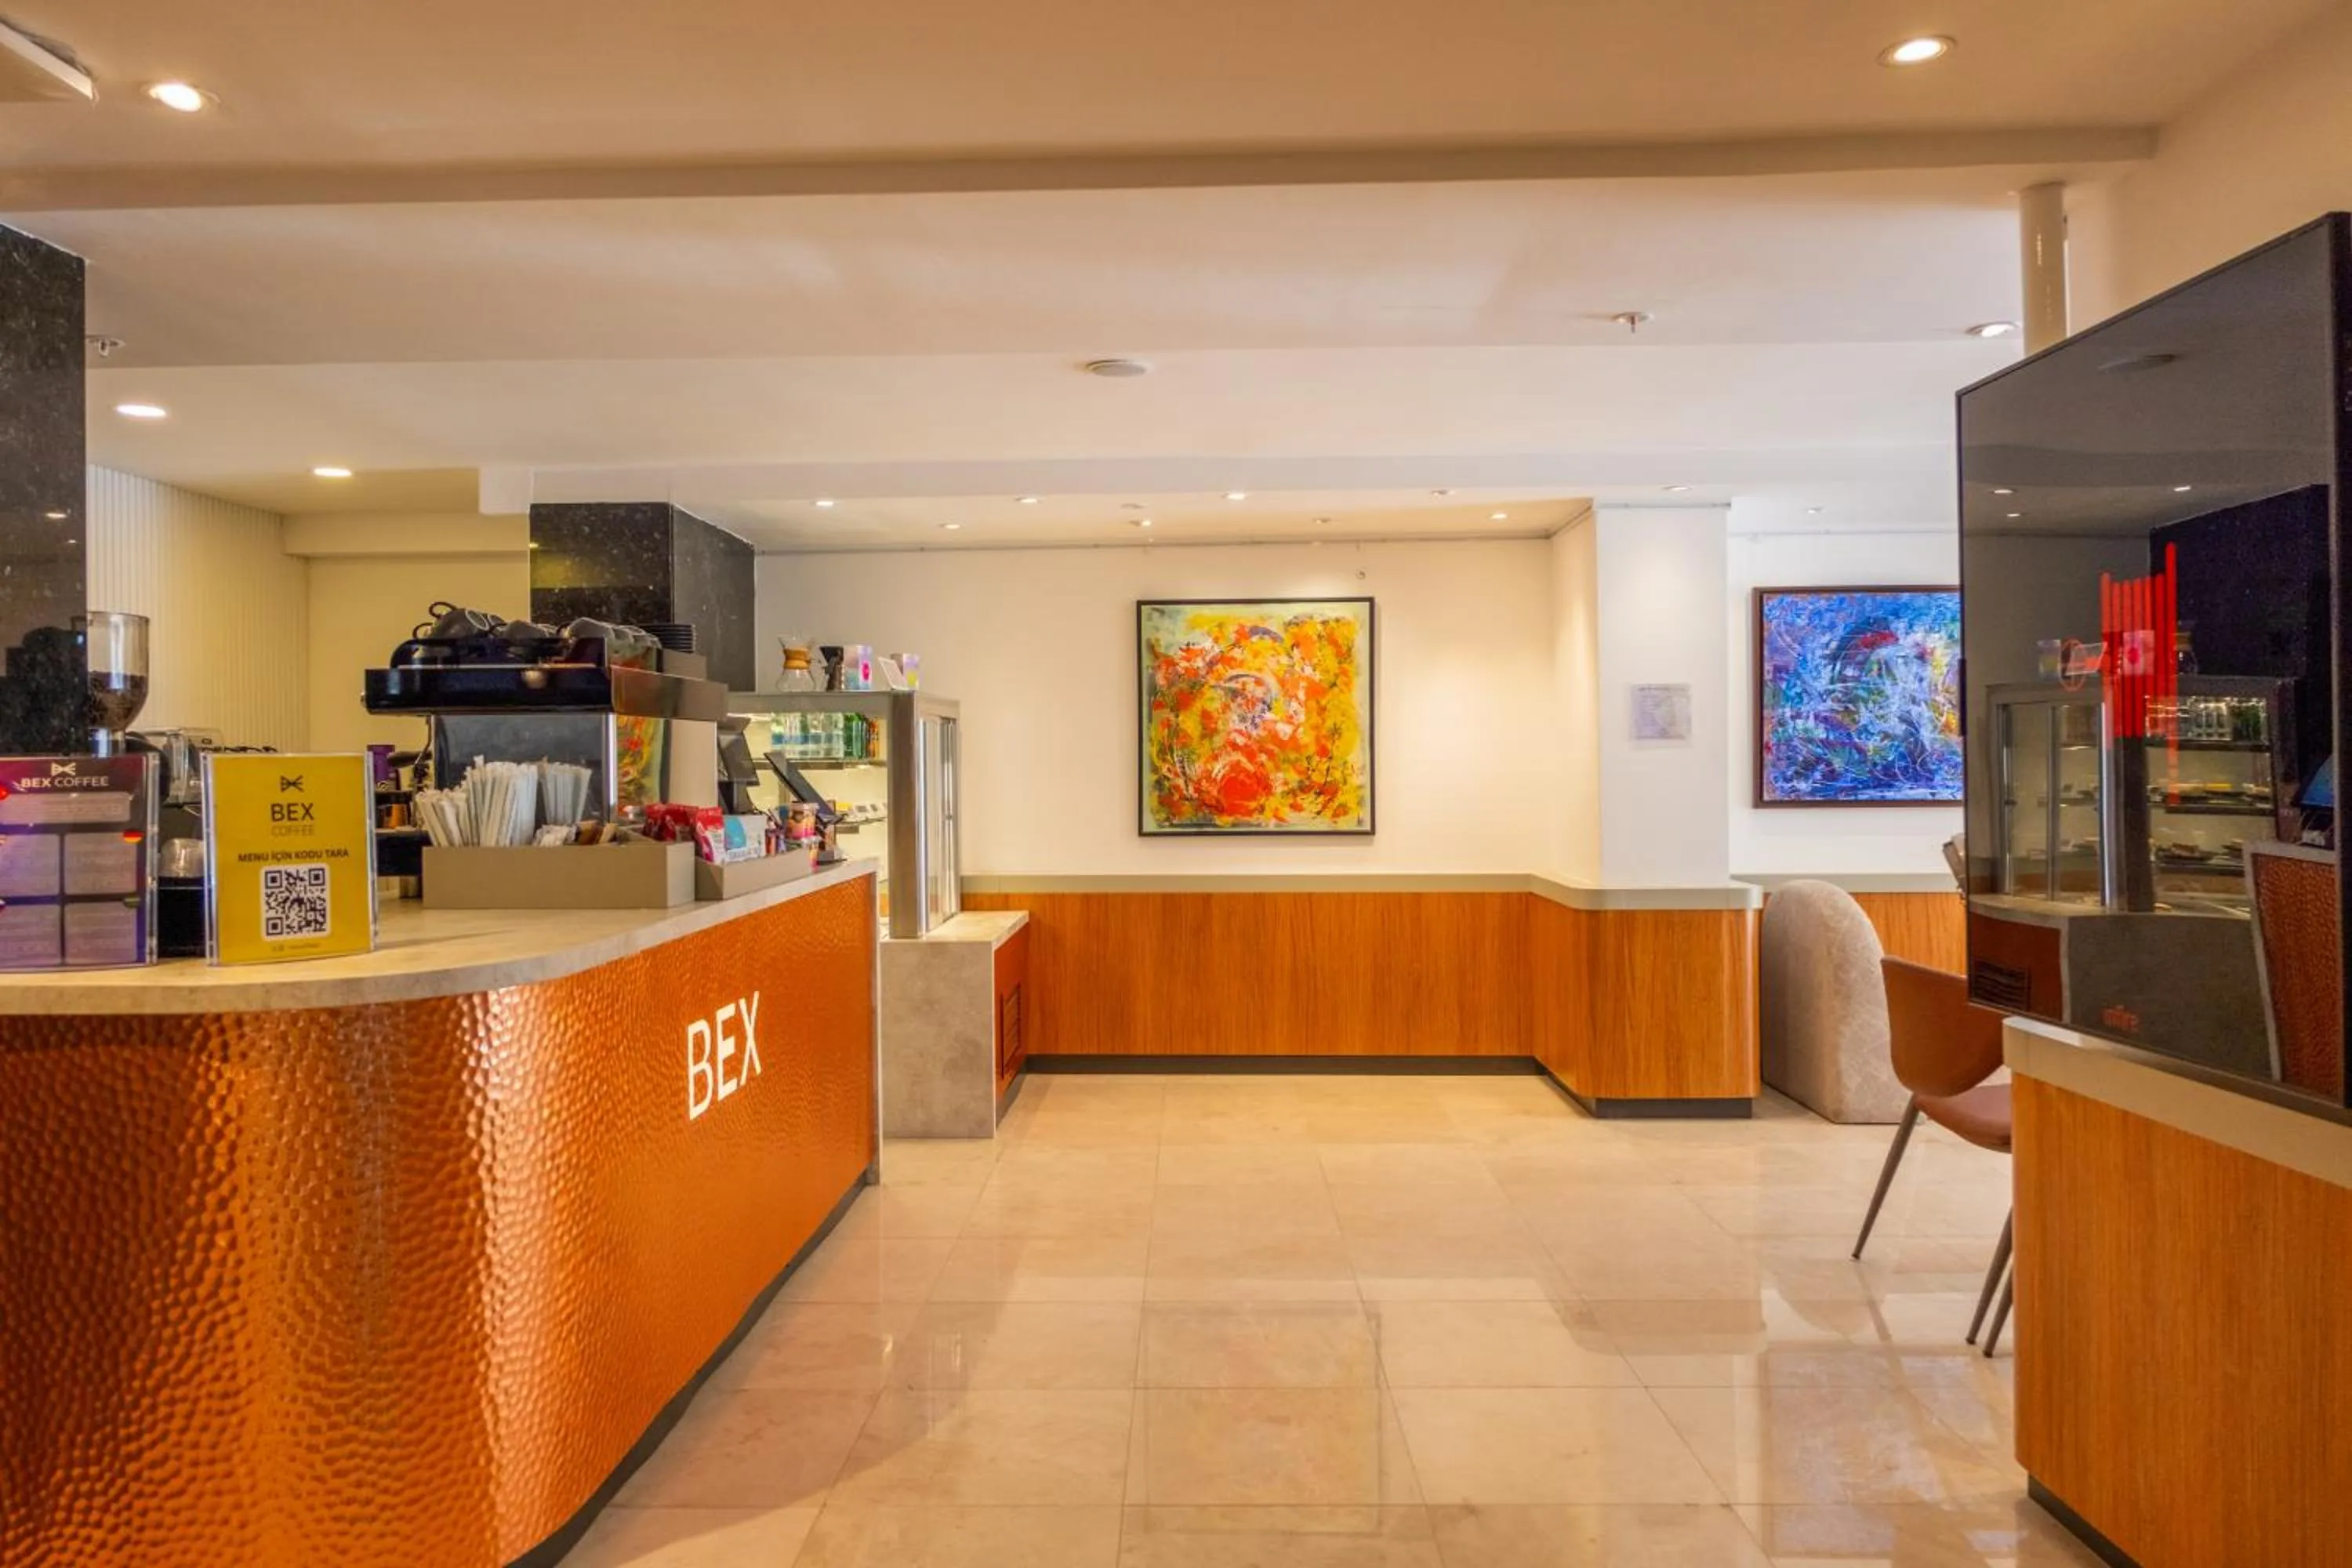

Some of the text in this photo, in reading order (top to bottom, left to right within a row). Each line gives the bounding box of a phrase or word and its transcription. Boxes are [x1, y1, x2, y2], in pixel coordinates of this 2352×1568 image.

[20, 775, 110, 788] BEX COFFEE
[270, 802, 314, 822] BEX
[271, 825, 314, 837] COFFEE
[293, 850, 322, 860] KODU
[325, 848, 350, 858] TARA
[688, 990, 762, 1121] BEX
